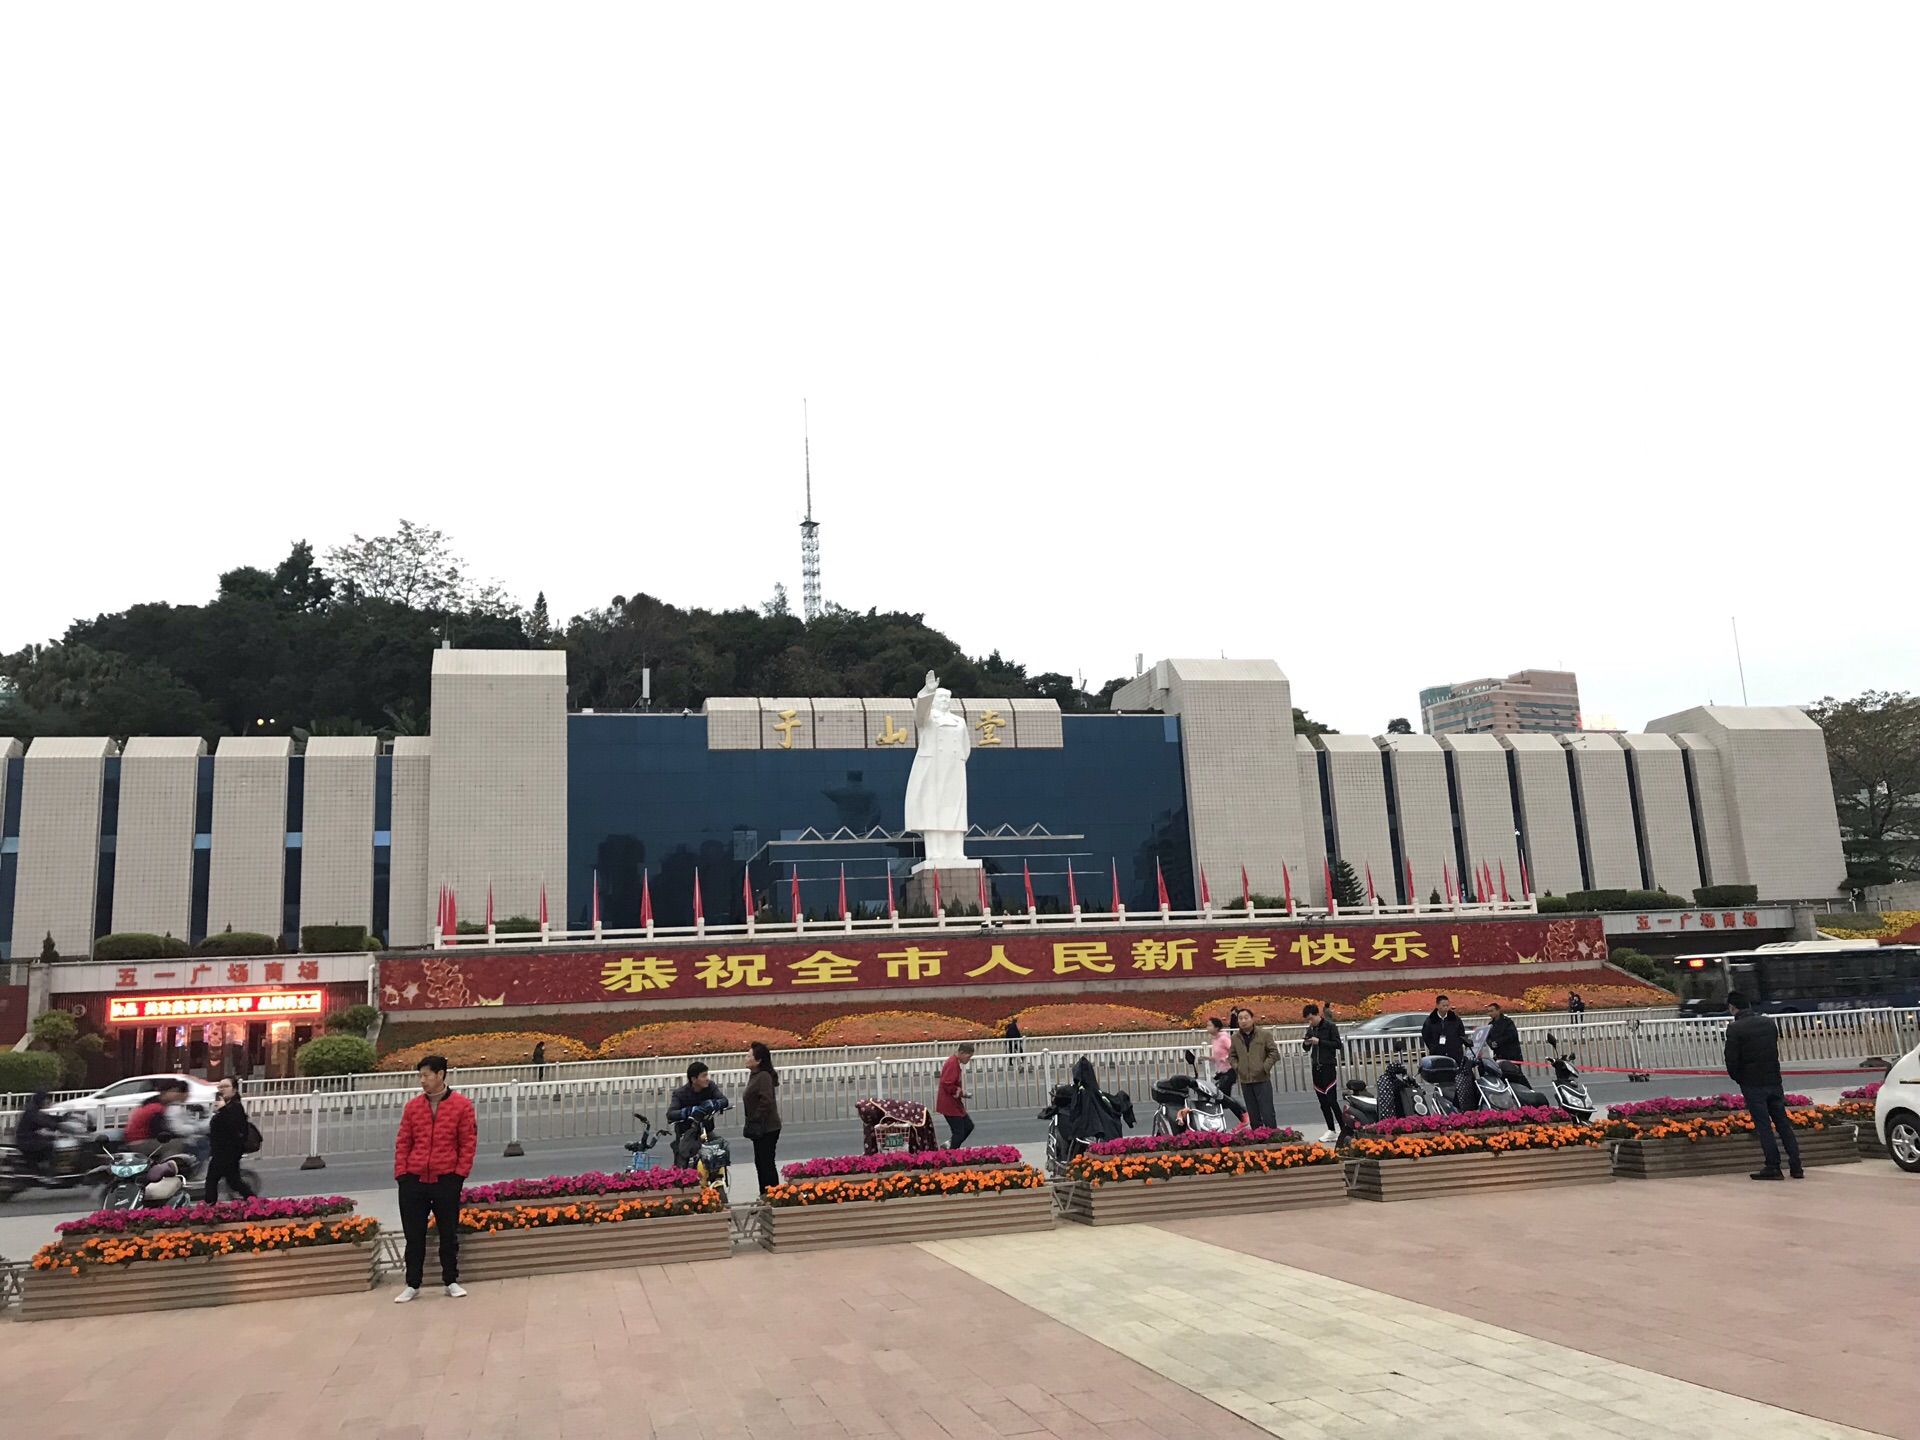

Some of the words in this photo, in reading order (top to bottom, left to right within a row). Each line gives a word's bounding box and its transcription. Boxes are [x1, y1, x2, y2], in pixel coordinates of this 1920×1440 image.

[773, 708, 1006, 749] 于山堂
[1636, 911, 1758, 930] 五一广场商场
[115, 960, 319, 987] 五一广场商场
